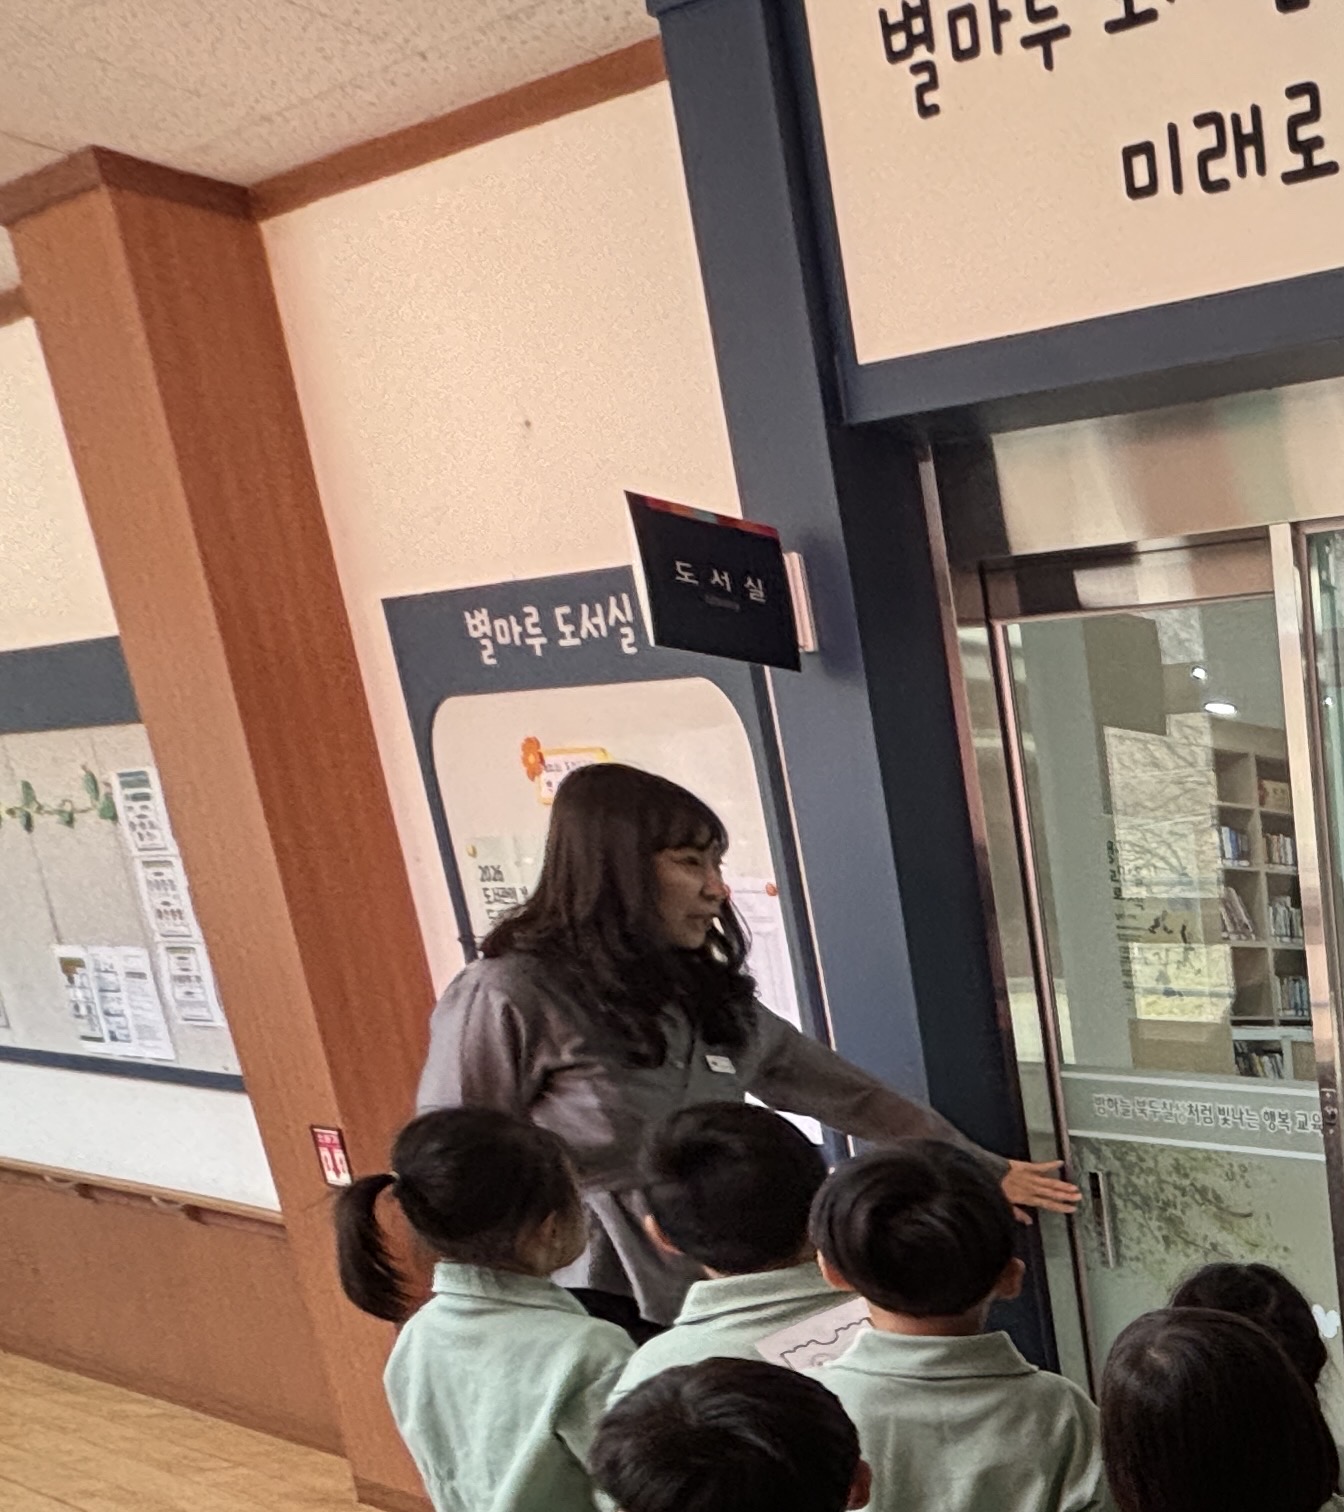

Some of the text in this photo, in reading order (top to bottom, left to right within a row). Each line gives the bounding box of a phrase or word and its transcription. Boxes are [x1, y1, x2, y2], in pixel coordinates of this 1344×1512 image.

[1120, 80, 1340, 200] 미래로
[463, 592, 638, 666] 별마루 도서실
[1217, 1104, 1260, 1130] 빛나는
[1262, 1107, 1292, 1134] 행복
